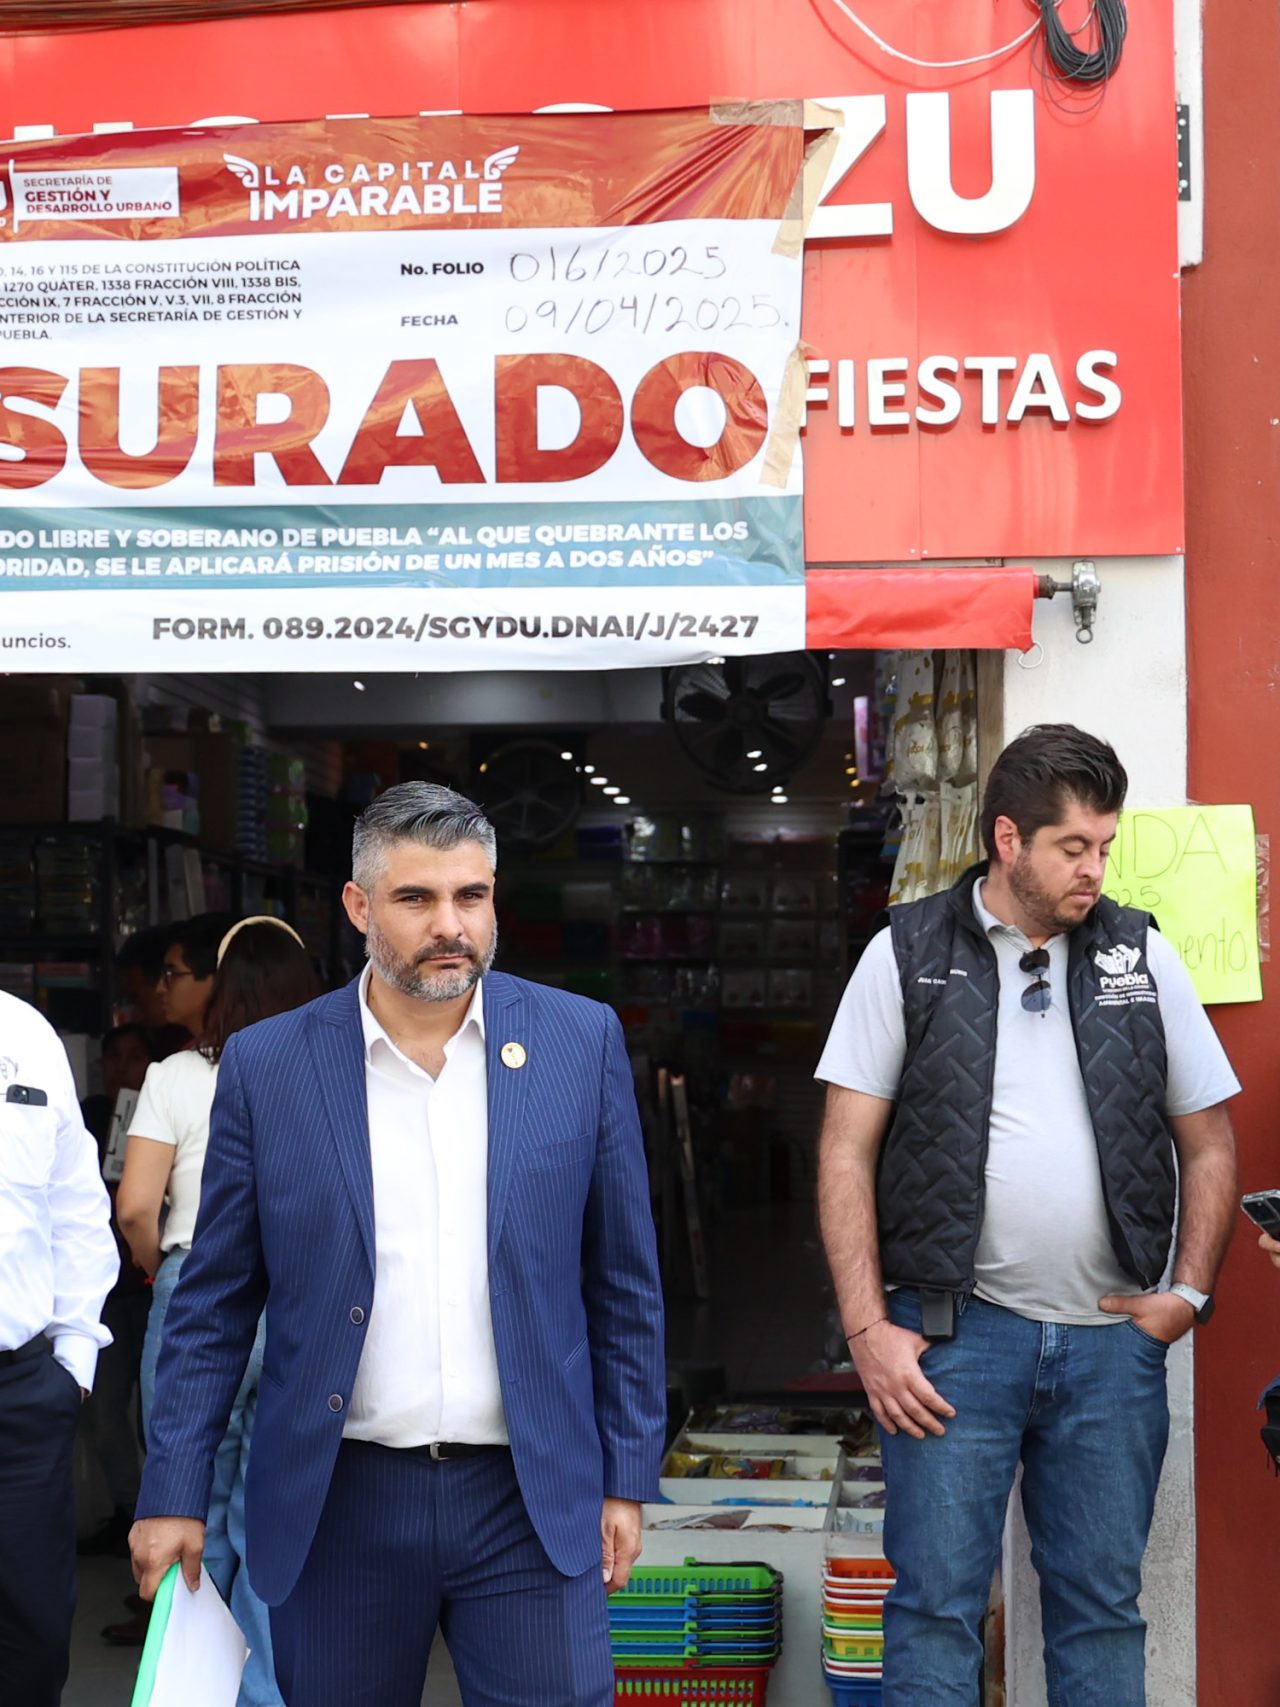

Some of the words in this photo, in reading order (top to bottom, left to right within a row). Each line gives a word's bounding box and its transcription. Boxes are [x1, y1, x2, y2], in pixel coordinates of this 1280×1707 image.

[265, 166, 306, 185] LA
[324, 160, 480, 184] CAPITAL
[23, 176, 93, 187] SECRETARÍA
[96, 176, 112, 185] DE
[25, 188, 96, 202] GESTIÓN
[98, 190, 110, 201] Y
[250, 183, 502, 221] IMPARABLE
[26, 202, 113, 214] DESARROLLO
[116, 201, 172, 212] URBANO
[126, 261, 232, 274] CONSTITUCIÓN
[236, 258, 300, 272] POLÍTICA
[401, 262, 429, 276] No.
[432, 262, 484, 275] FOLIO
[4, 282, 34, 292] 1270
[102, 280, 131, 290] 1338
[135, 276, 208, 290] FRACCIÓN
[242, 277, 271, 288] 1338
[74, 293, 146, 307] FRACCIÓN
[229, 290, 301, 304] FRACCIÓN
[110, 308, 198, 322] SECRETARÍA
[227, 306, 288, 320] GESTIÓN
[401, 314, 458, 328] FECHA
[799, 349, 1122, 428] FIESTAS
[39, 530, 109, 548] LIBRE
[115, 530, 132, 547] Y
[136, 529, 278, 548] SOBERANO
[282, 529, 316, 547] DE
[322, 527, 422, 547] PUEBLA
[477, 526, 530, 547] QUE
[535, 523, 694, 545] QUEBRANTE
[699, 522, 748, 541] LOS
[95, 557, 127, 576] SE
[131, 558, 161, 575] LE
[165, 552, 293, 575] APLICARÁ
[298, 551, 400, 573] PRISIÓN
[405, 554, 439, 571] DE
[444, 552, 481, 570] UN
[486, 551, 541, 569] MES
[544, 550, 565, 568] A
[570, 550, 624, 568] DOS
[152, 617, 254, 640] FORM.
[263, 613, 759, 641] 089.2024/SGYDU.DNAI/J/2427
[1100, 972, 1148, 988] Puebla
